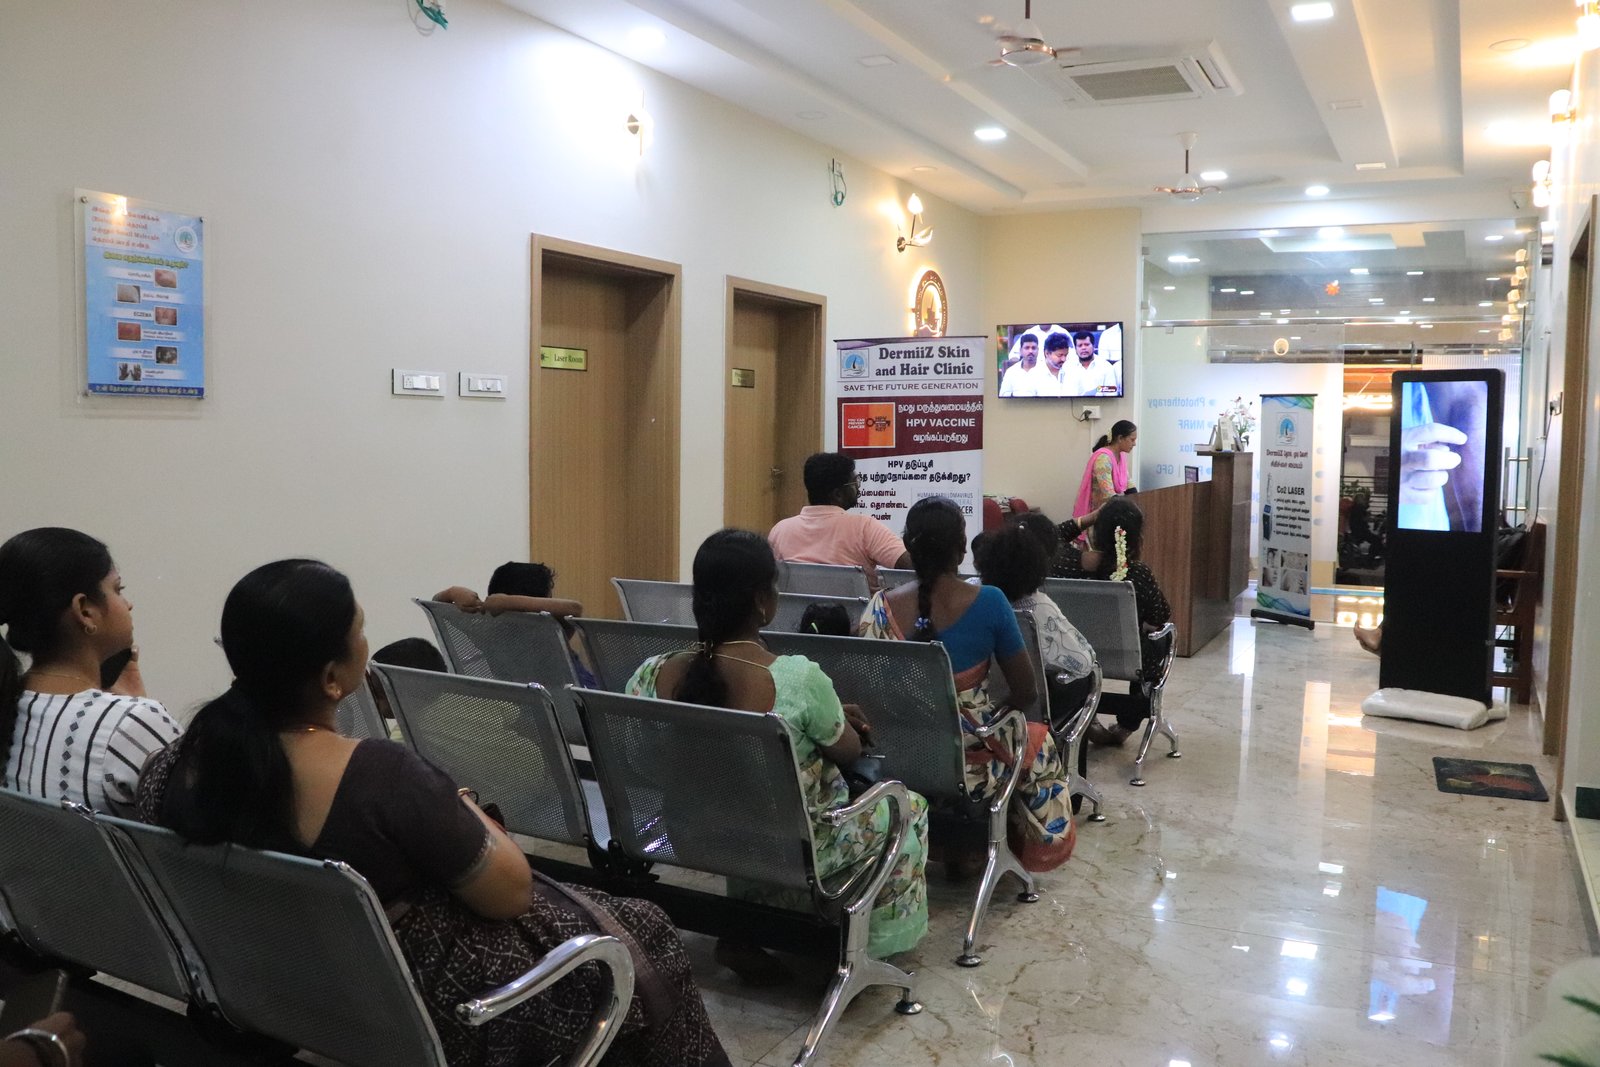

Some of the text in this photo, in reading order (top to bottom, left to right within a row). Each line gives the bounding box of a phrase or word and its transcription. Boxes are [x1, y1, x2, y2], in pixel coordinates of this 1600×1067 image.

[879, 345, 970, 360] DermiiZ Skin
[875, 362, 974, 376] and Hair Clinic
[921, 382, 978, 390] GENERATION
[898, 404, 915, 414] நமது
[906, 418, 976, 427] HPV VACCINE
[888, 459, 934, 472] HPV தடுப்பூசி
[1288, 487, 1305, 495] LASER
